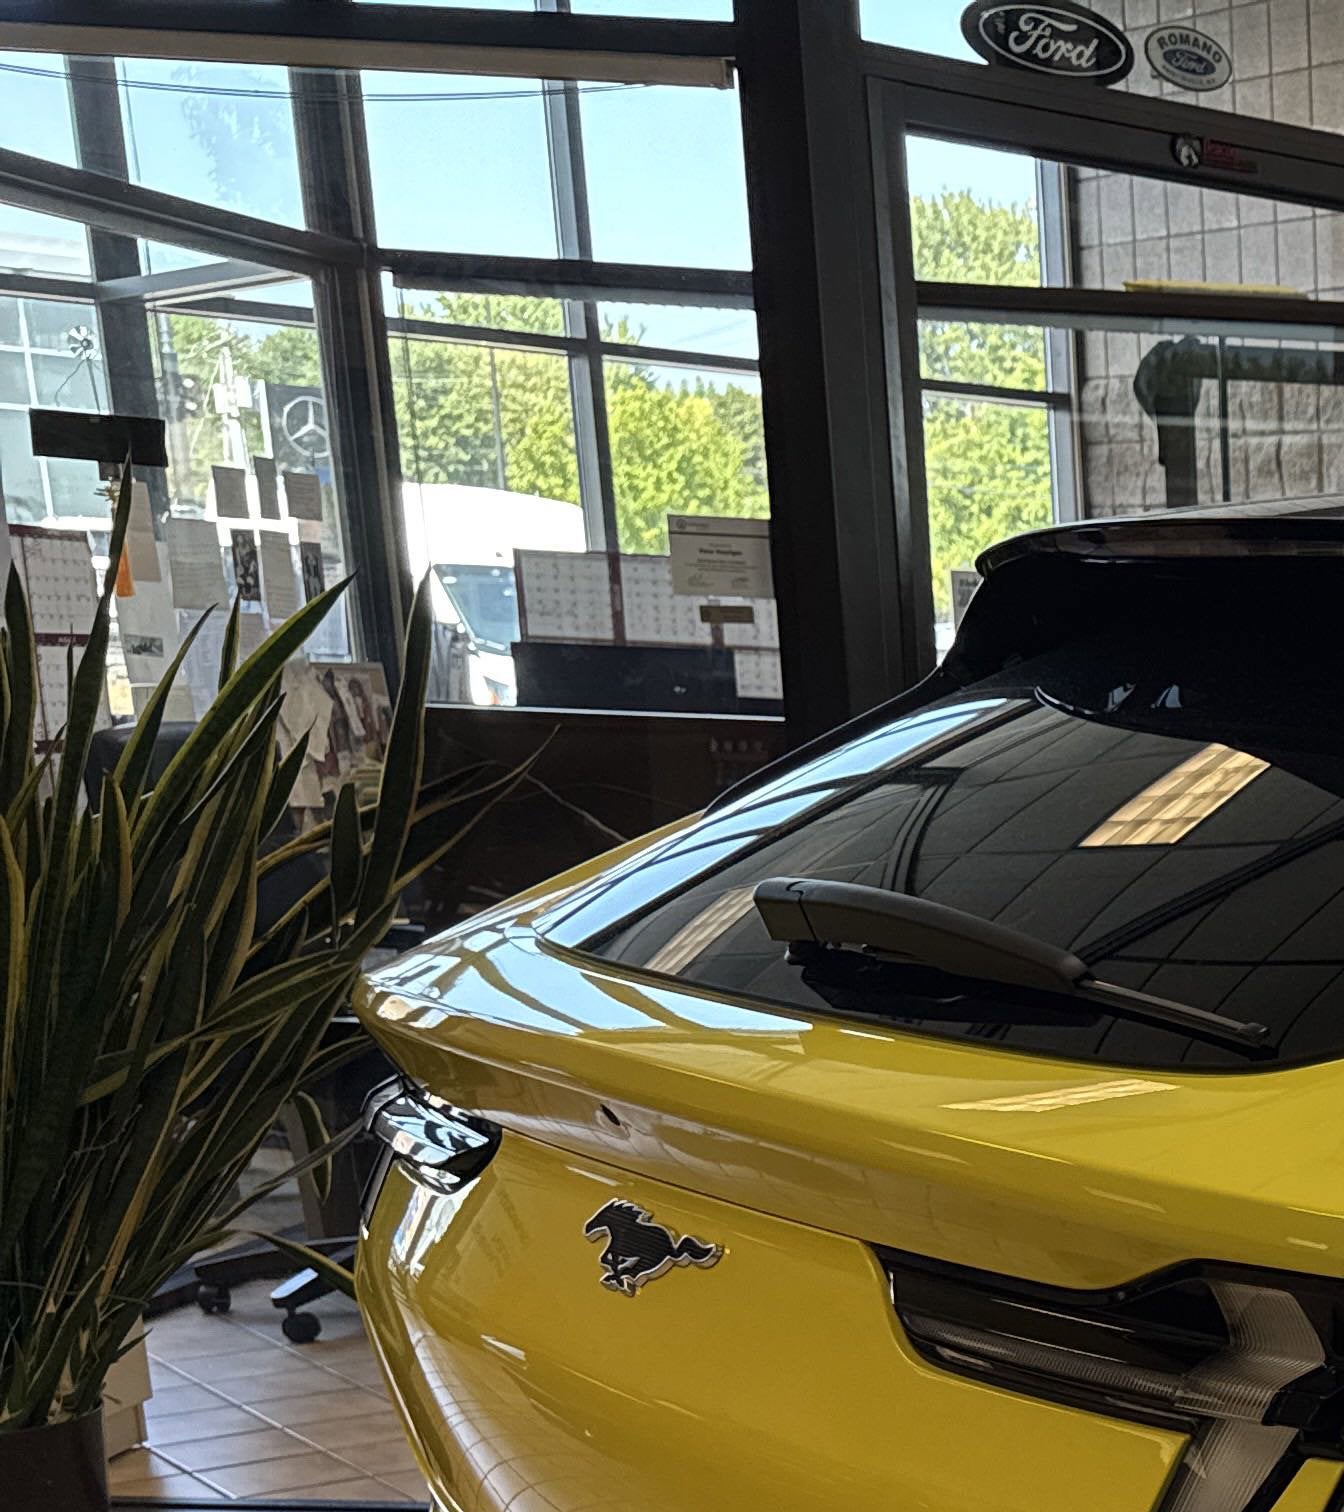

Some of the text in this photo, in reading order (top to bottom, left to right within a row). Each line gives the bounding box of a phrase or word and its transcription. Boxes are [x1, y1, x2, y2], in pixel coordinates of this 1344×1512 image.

[1008, 12, 1099, 68] Ford
[1157, 32, 1223, 63] ROMANO
[1172, 51, 1208, 75] Ford
